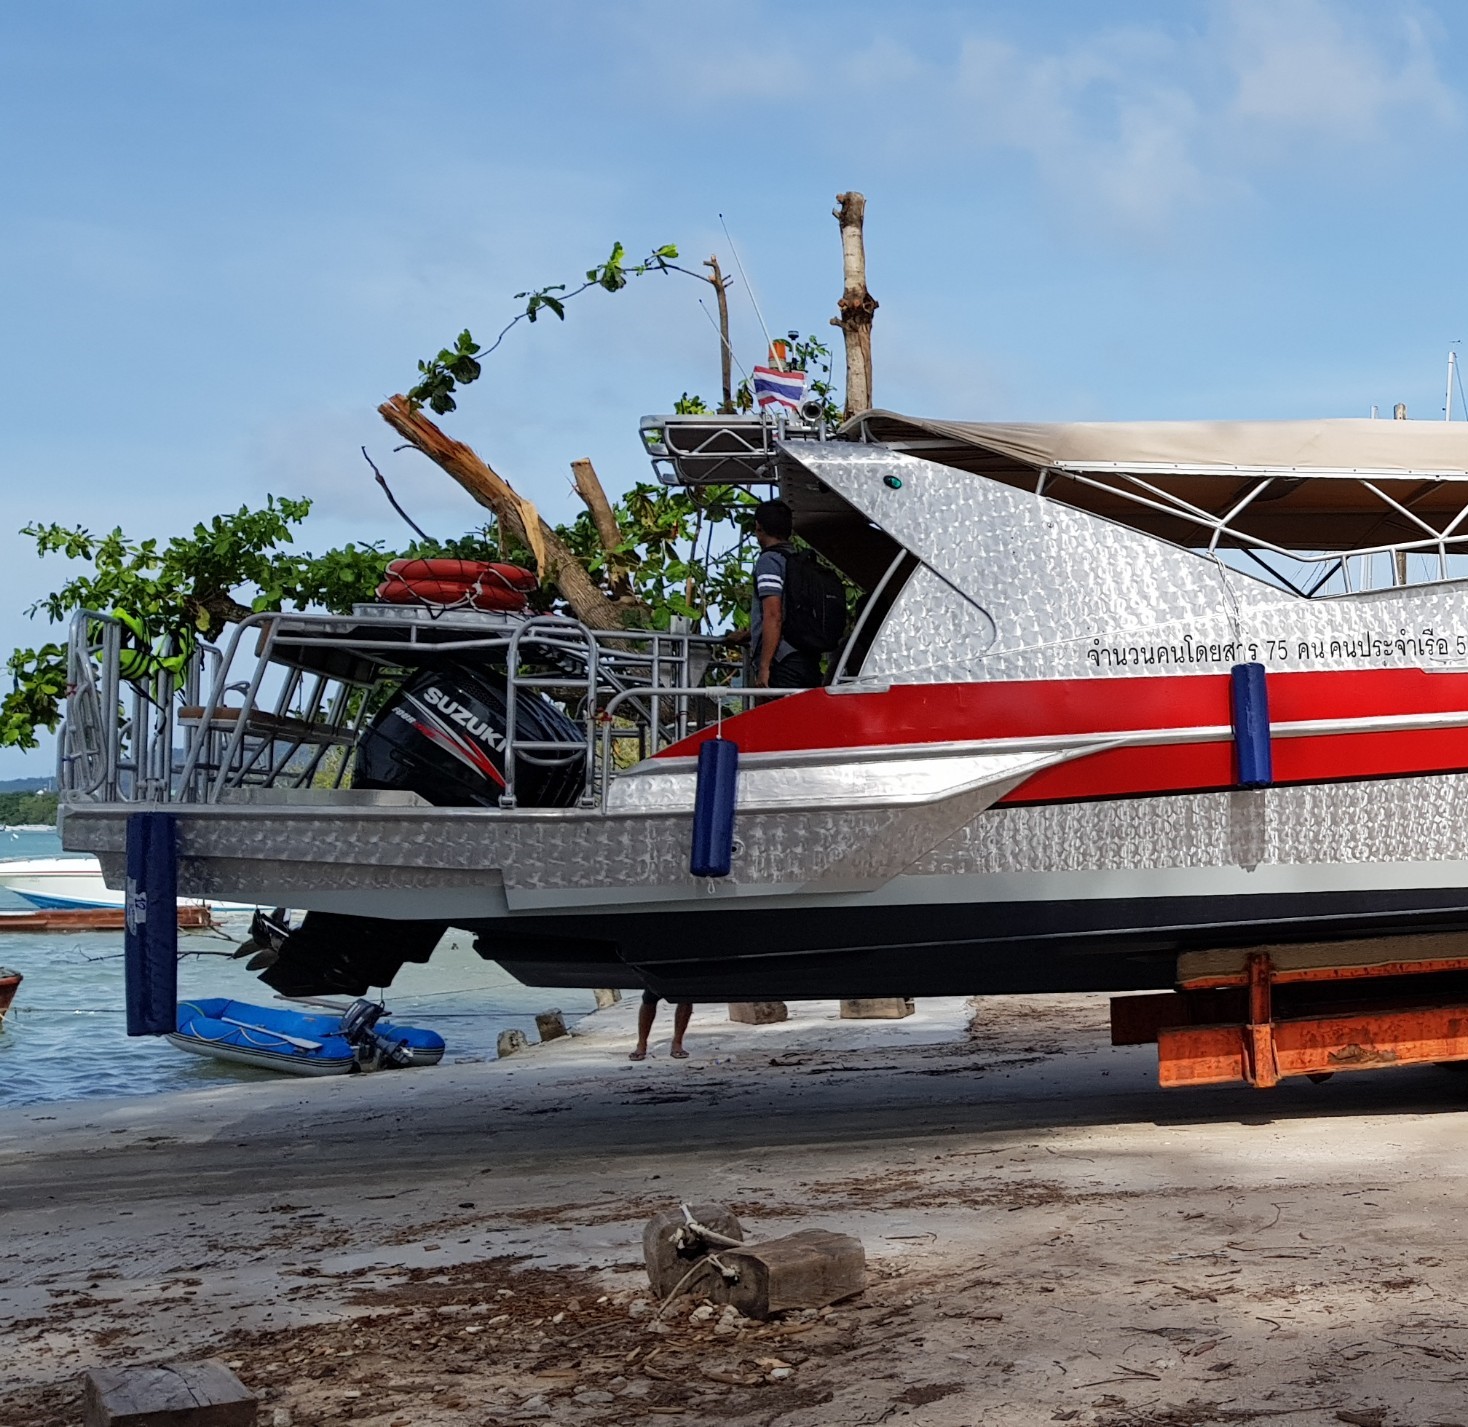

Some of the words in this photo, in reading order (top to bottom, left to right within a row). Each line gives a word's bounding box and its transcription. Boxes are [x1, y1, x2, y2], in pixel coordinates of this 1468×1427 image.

[1266, 640, 1288, 661] 75
[1298, 639, 1325, 660] คน
[1456, 635, 1467, 655] 5
[423, 686, 507, 752] SUZUKI
